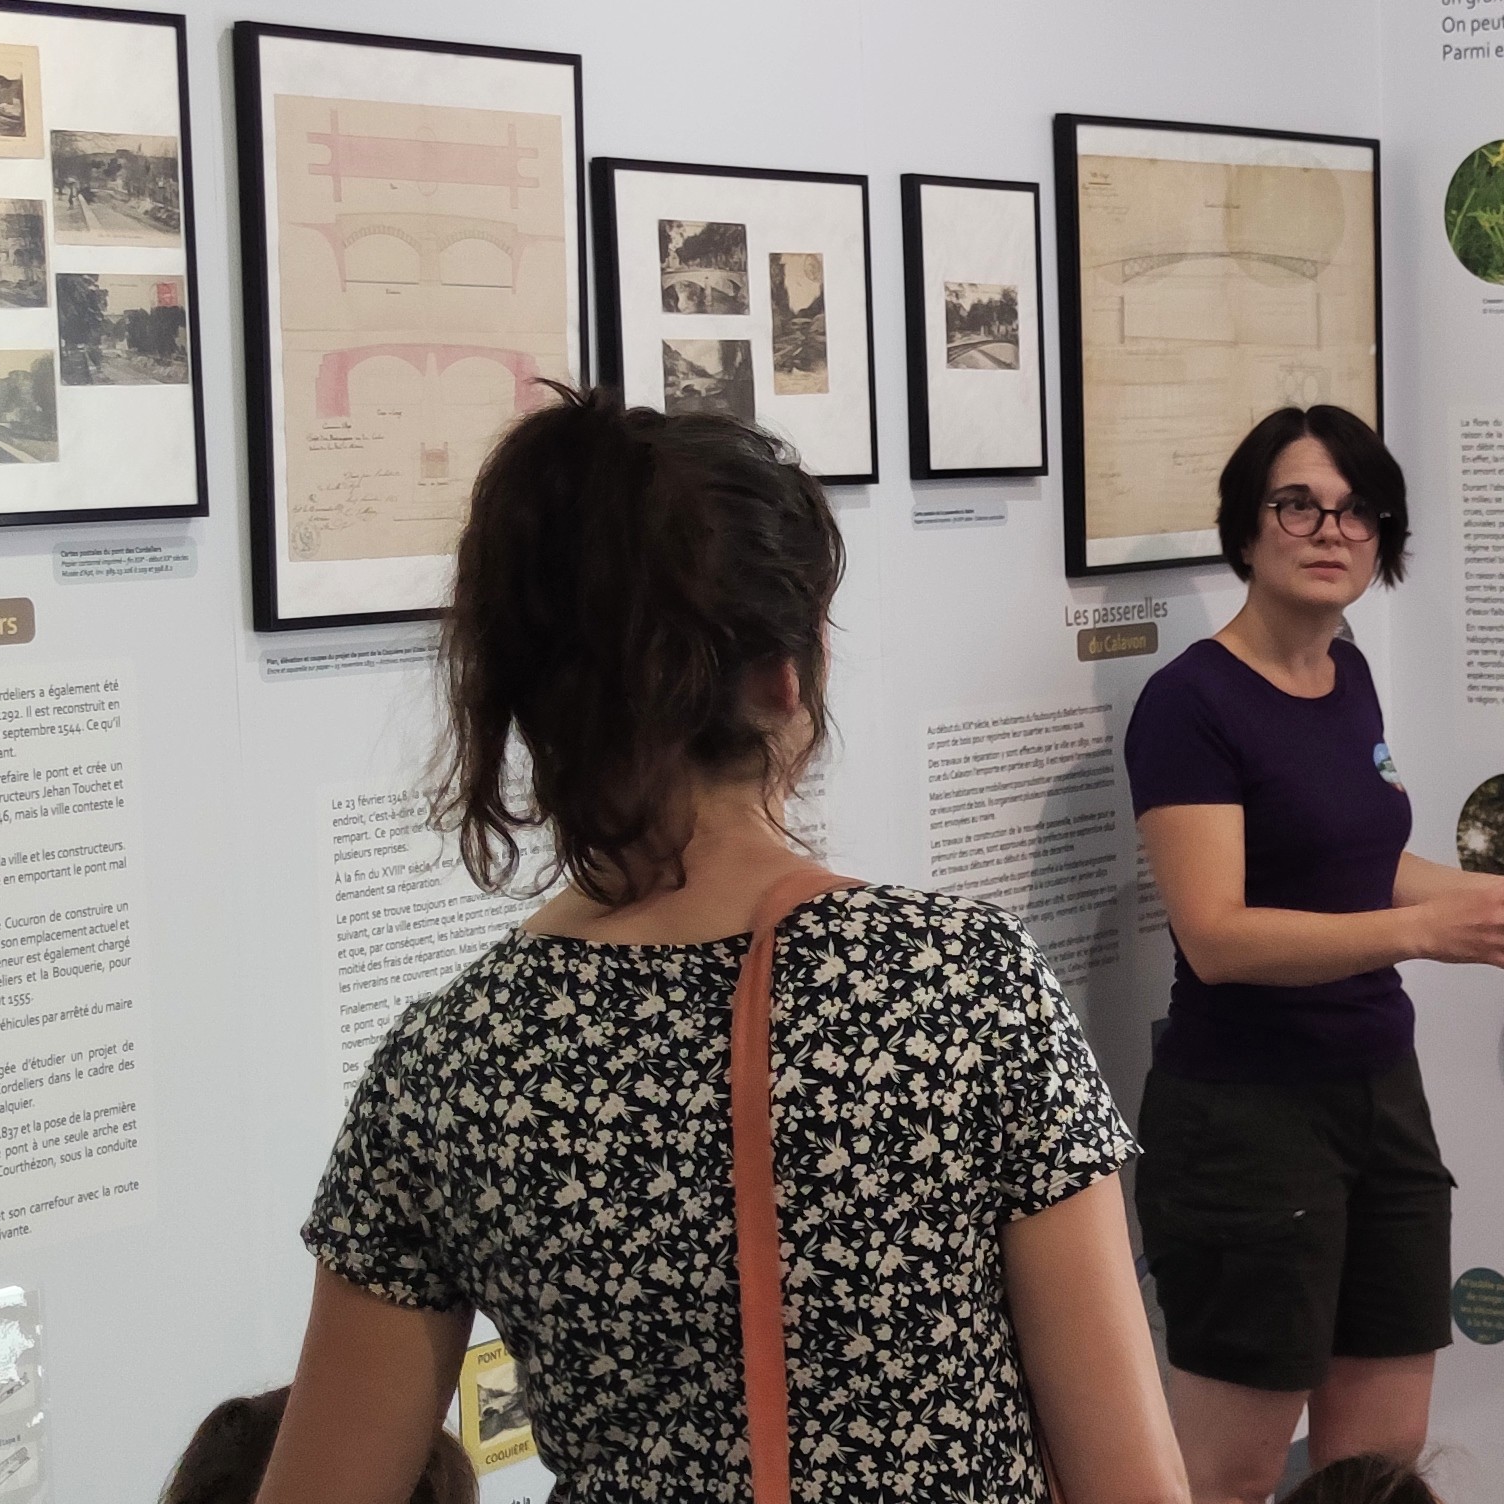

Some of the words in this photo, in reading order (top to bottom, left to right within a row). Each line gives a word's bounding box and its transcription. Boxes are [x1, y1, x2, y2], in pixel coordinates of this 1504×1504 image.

[1442, 42, 1490, 60] Parmi
[1064, 605, 1089, 627] Les
[1092, 595, 1167, 628] passerelles
[1087, 635, 1102, 654] du
[1104, 633, 1146, 652] Calavon
[38, 688, 45, 698] a
[48, 682, 100, 700] également
[103, 678, 118, 692] été
